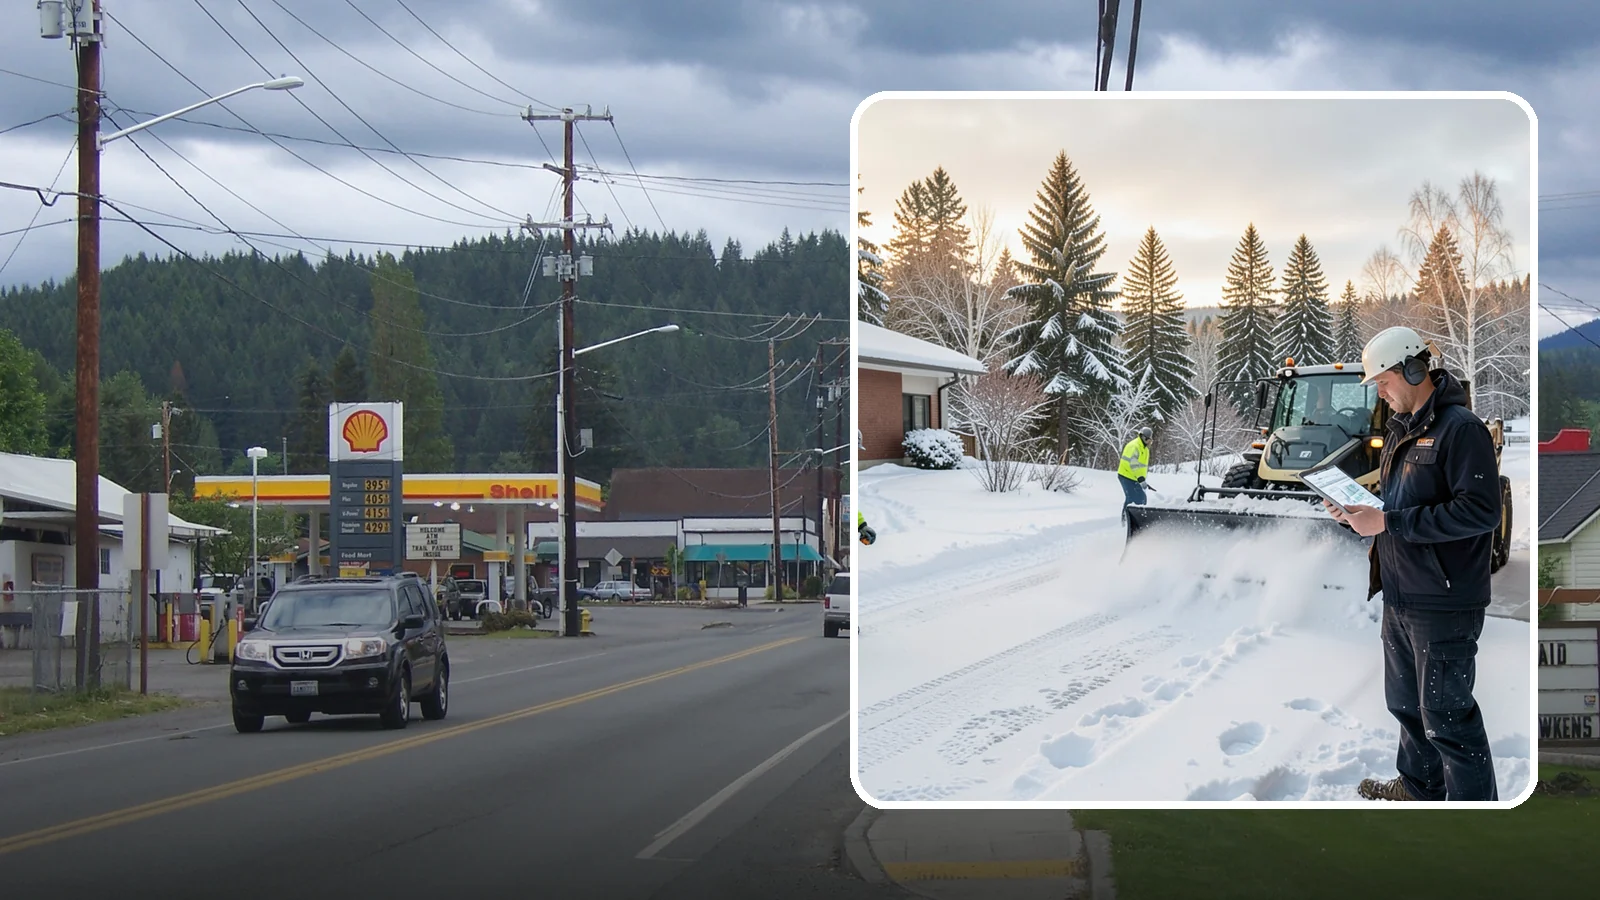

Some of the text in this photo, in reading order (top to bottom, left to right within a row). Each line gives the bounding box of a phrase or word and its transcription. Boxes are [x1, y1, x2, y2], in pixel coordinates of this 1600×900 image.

[490, 484, 548, 498] Shell
[1539, 643, 1567, 665] AID
[1539, 716, 1592, 739] WKENS
